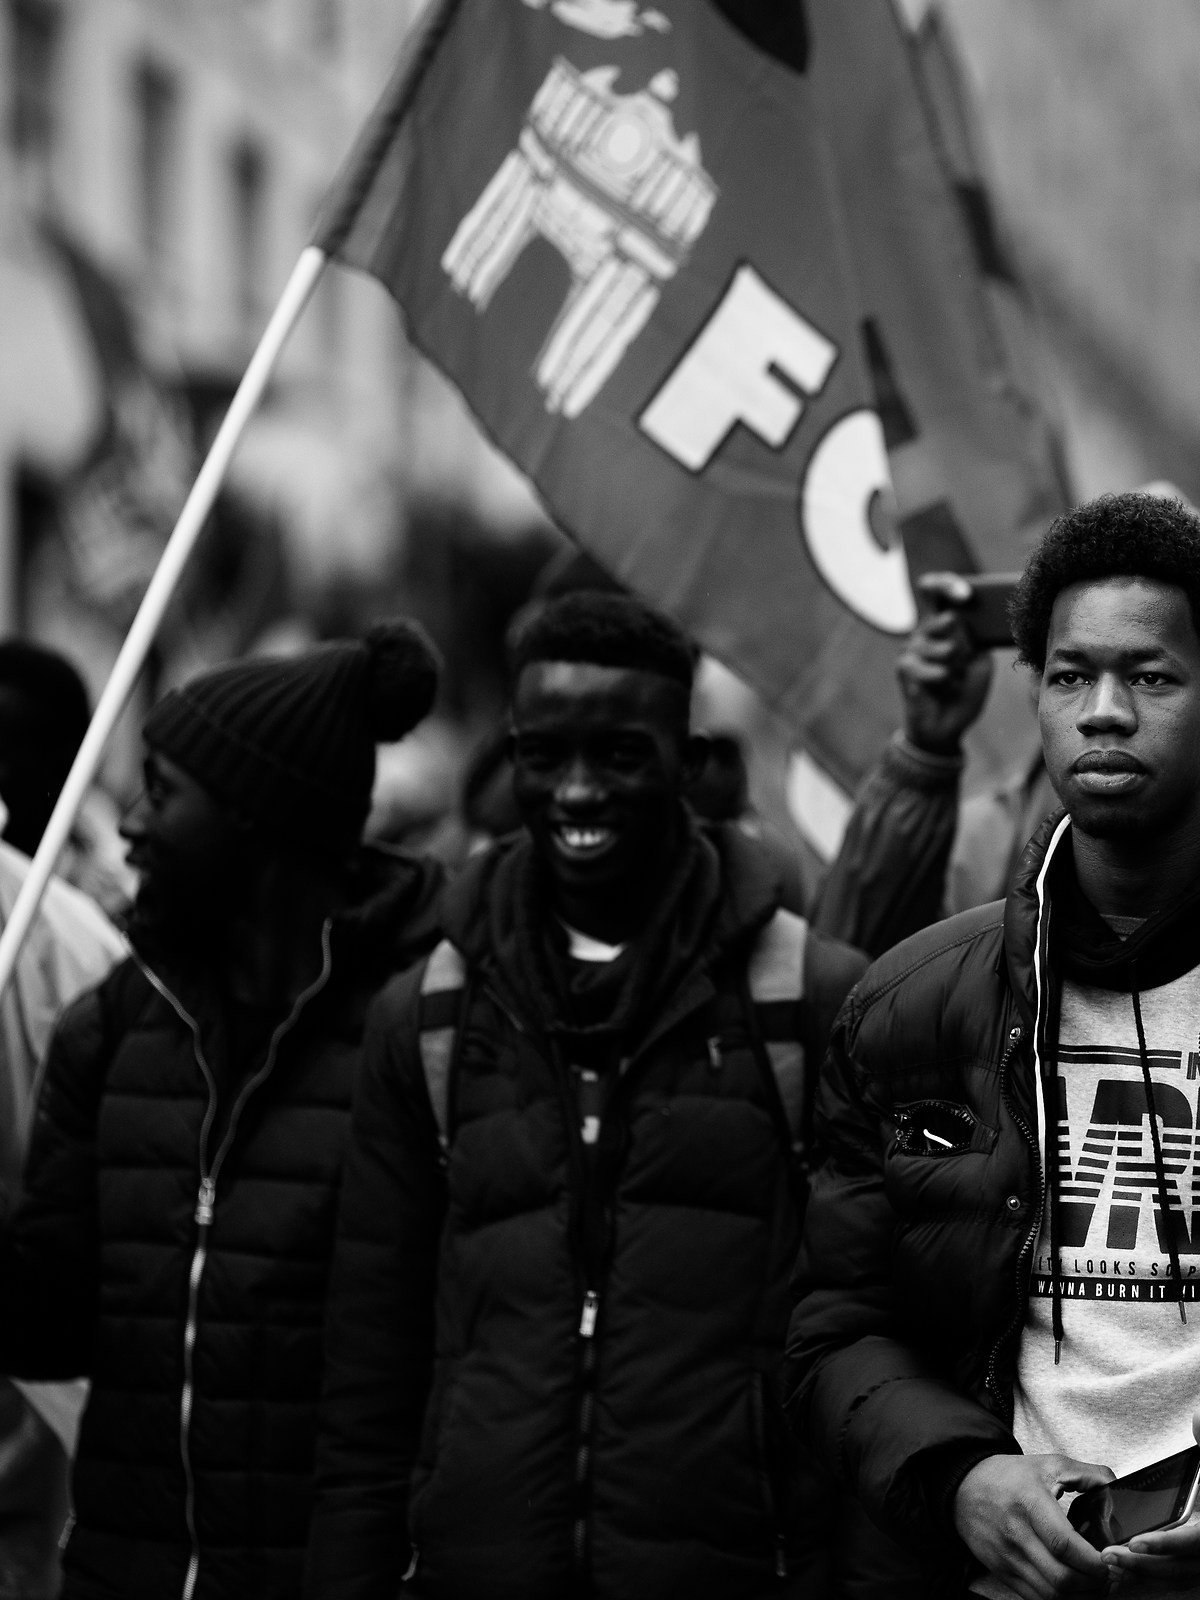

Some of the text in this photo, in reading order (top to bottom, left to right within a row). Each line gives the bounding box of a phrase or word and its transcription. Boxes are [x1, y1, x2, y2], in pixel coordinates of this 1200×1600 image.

[1074, 1259, 1136, 1275] LOOKS
[1150, 1263, 1173, 1276] SO
[1095, 1283, 1140, 1298] BURN
[1150, 1285, 1166, 1299] IT
